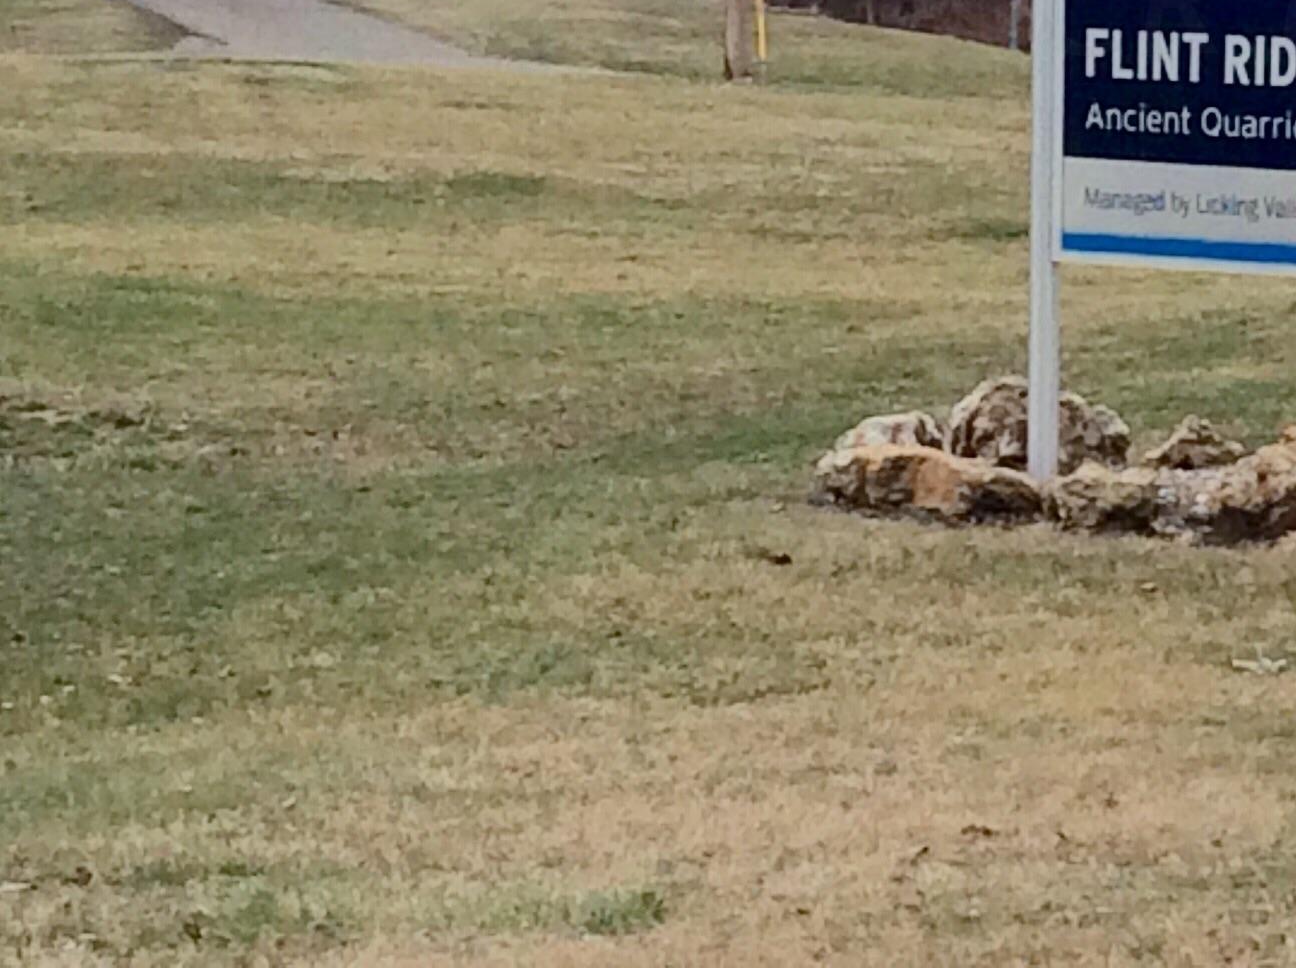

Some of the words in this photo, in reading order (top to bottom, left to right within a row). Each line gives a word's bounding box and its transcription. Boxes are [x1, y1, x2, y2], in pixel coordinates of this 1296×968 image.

[1084, 28, 1209, 83] FLINT
[1085, 102, 1191, 135] Ancient
[1084, 187, 1166, 217] Managed
[1171, 190, 1191, 219] by
